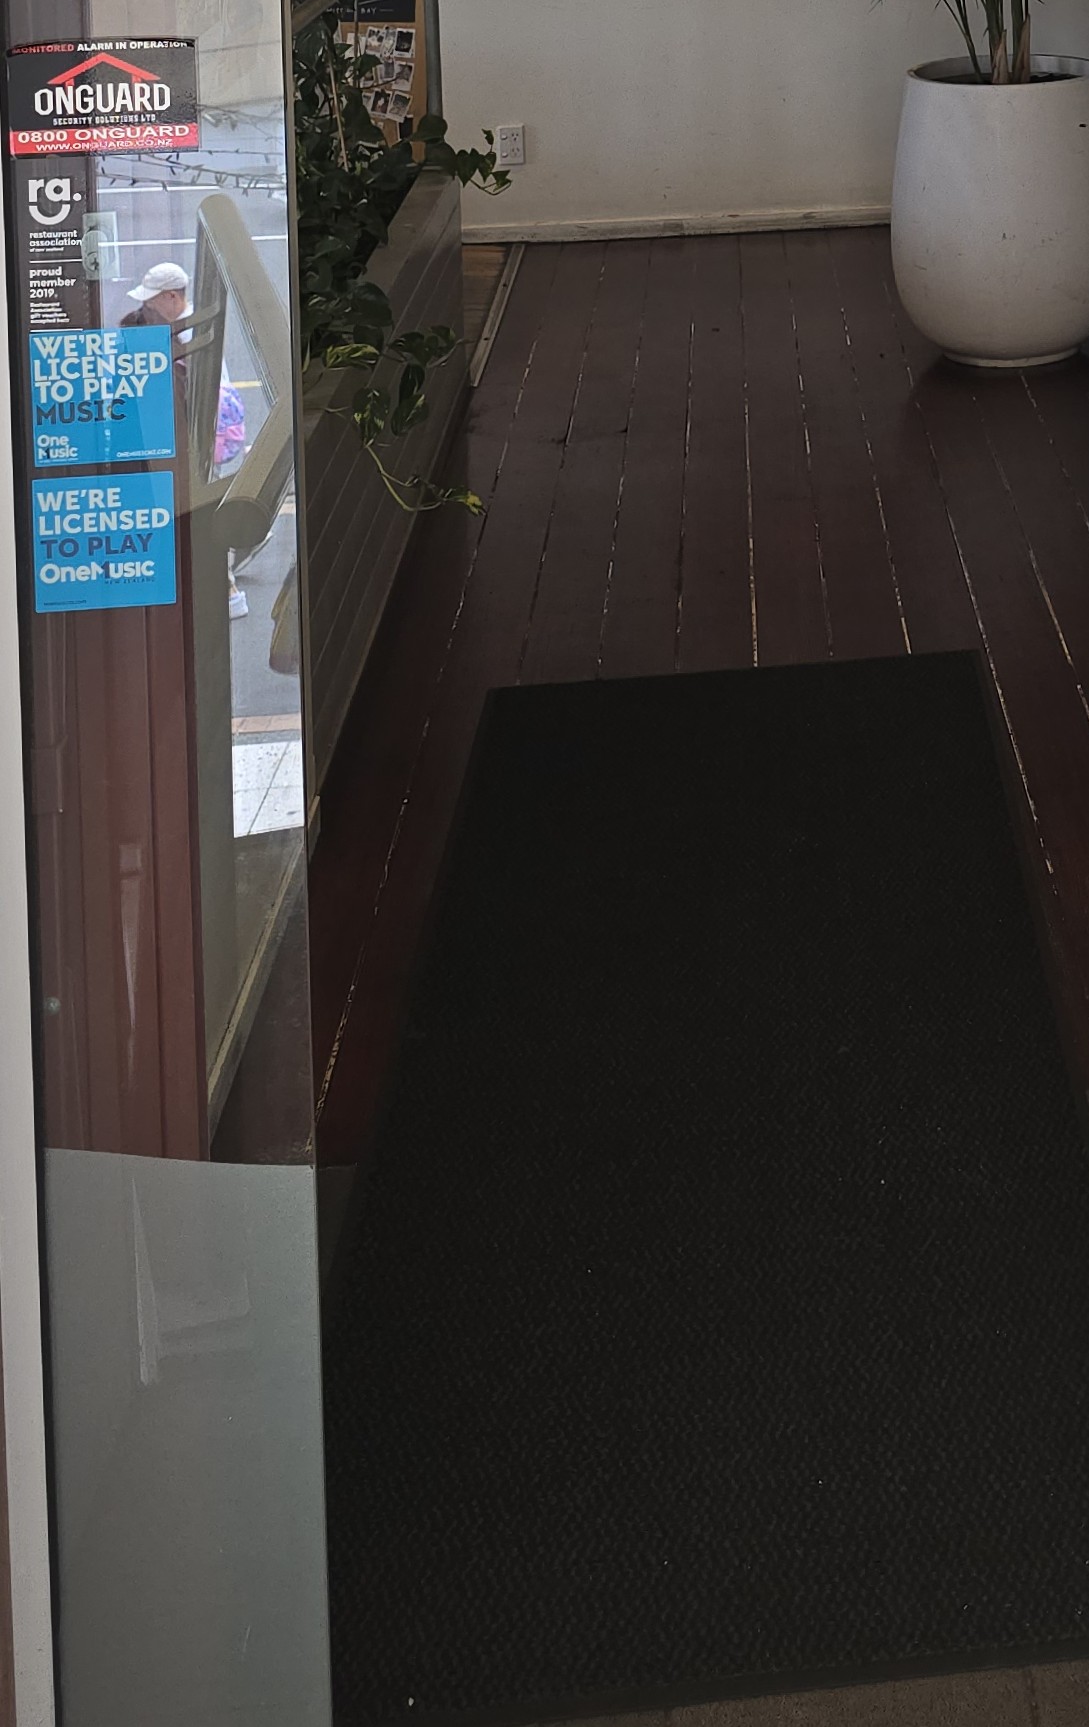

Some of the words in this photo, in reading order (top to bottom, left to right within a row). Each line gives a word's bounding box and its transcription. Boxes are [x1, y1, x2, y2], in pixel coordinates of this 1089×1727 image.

[77, 43, 113, 51] ALARM
[116, 42, 127, 50] IN
[129, 40, 188, 50] OPERATION
[34, 83, 171, 116] ONGUARD
[18, 130, 68, 143] 0800
[74, 125, 190, 140] ONGUARD
[36, 138, 173, 151] WWW.ONGUARD.CO.NZ
[30, 230, 78, 239] restaurant
[30, 238, 82, 247] association
[30, 266, 62, 279] proud
[30, 277, 76, 288] member
[33, 333, 118, 359] WE'RE
[34, 352, 168, 381] LICENSED
[35, 380, 73, 403] TO
[84, 375, 149, 400] PLAY
[36, 398, 126, 425] MUSIC
[38, 435, 69, 446] One
[37, 488, 121, 512] WE'RE
[39, 508, 170, 535] LICENSED
[40, 538, 79, 559] TO
[88, 533, 153, 556] PLAY
